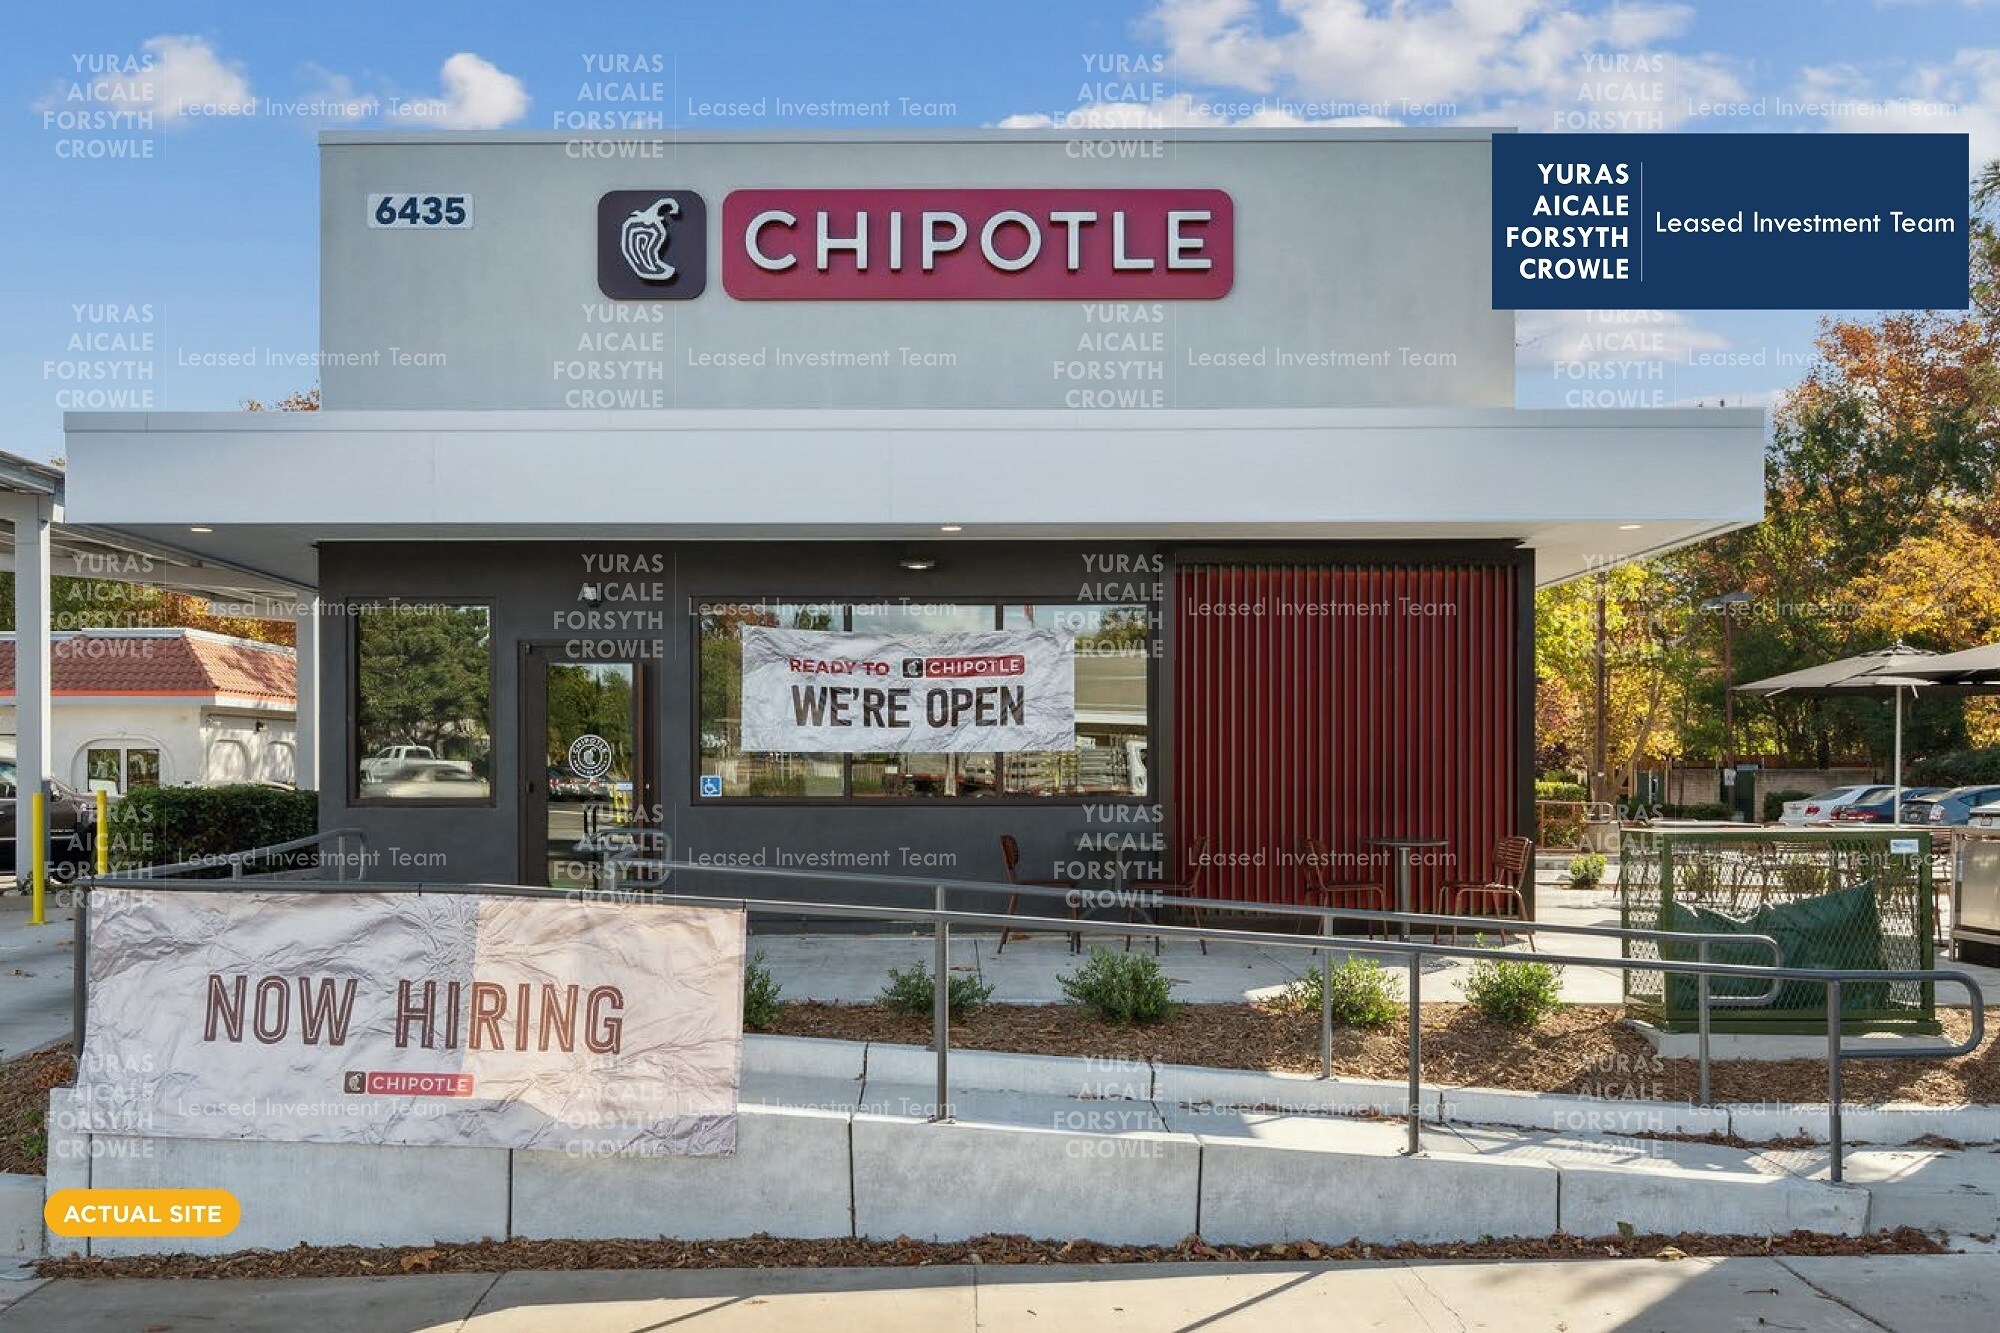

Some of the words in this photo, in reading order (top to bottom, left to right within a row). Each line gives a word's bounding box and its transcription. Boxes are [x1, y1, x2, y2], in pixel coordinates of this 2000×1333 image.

[374, 196, 467, 226] 6435
[744, 210, 1213, 273] CHIPOTLE
[789, 657, 857, 676] READY
[862, 661, 890, 676] TO
[929, 659, 1020, 675] CHIPOTLE
[926, 685, 1025, 728] OPEN
[204, 974, 358, 1046] NOW
[394, 979, 625, 1055] HIRING
[372, 1076, 470, 1092] CHIPOTLE
